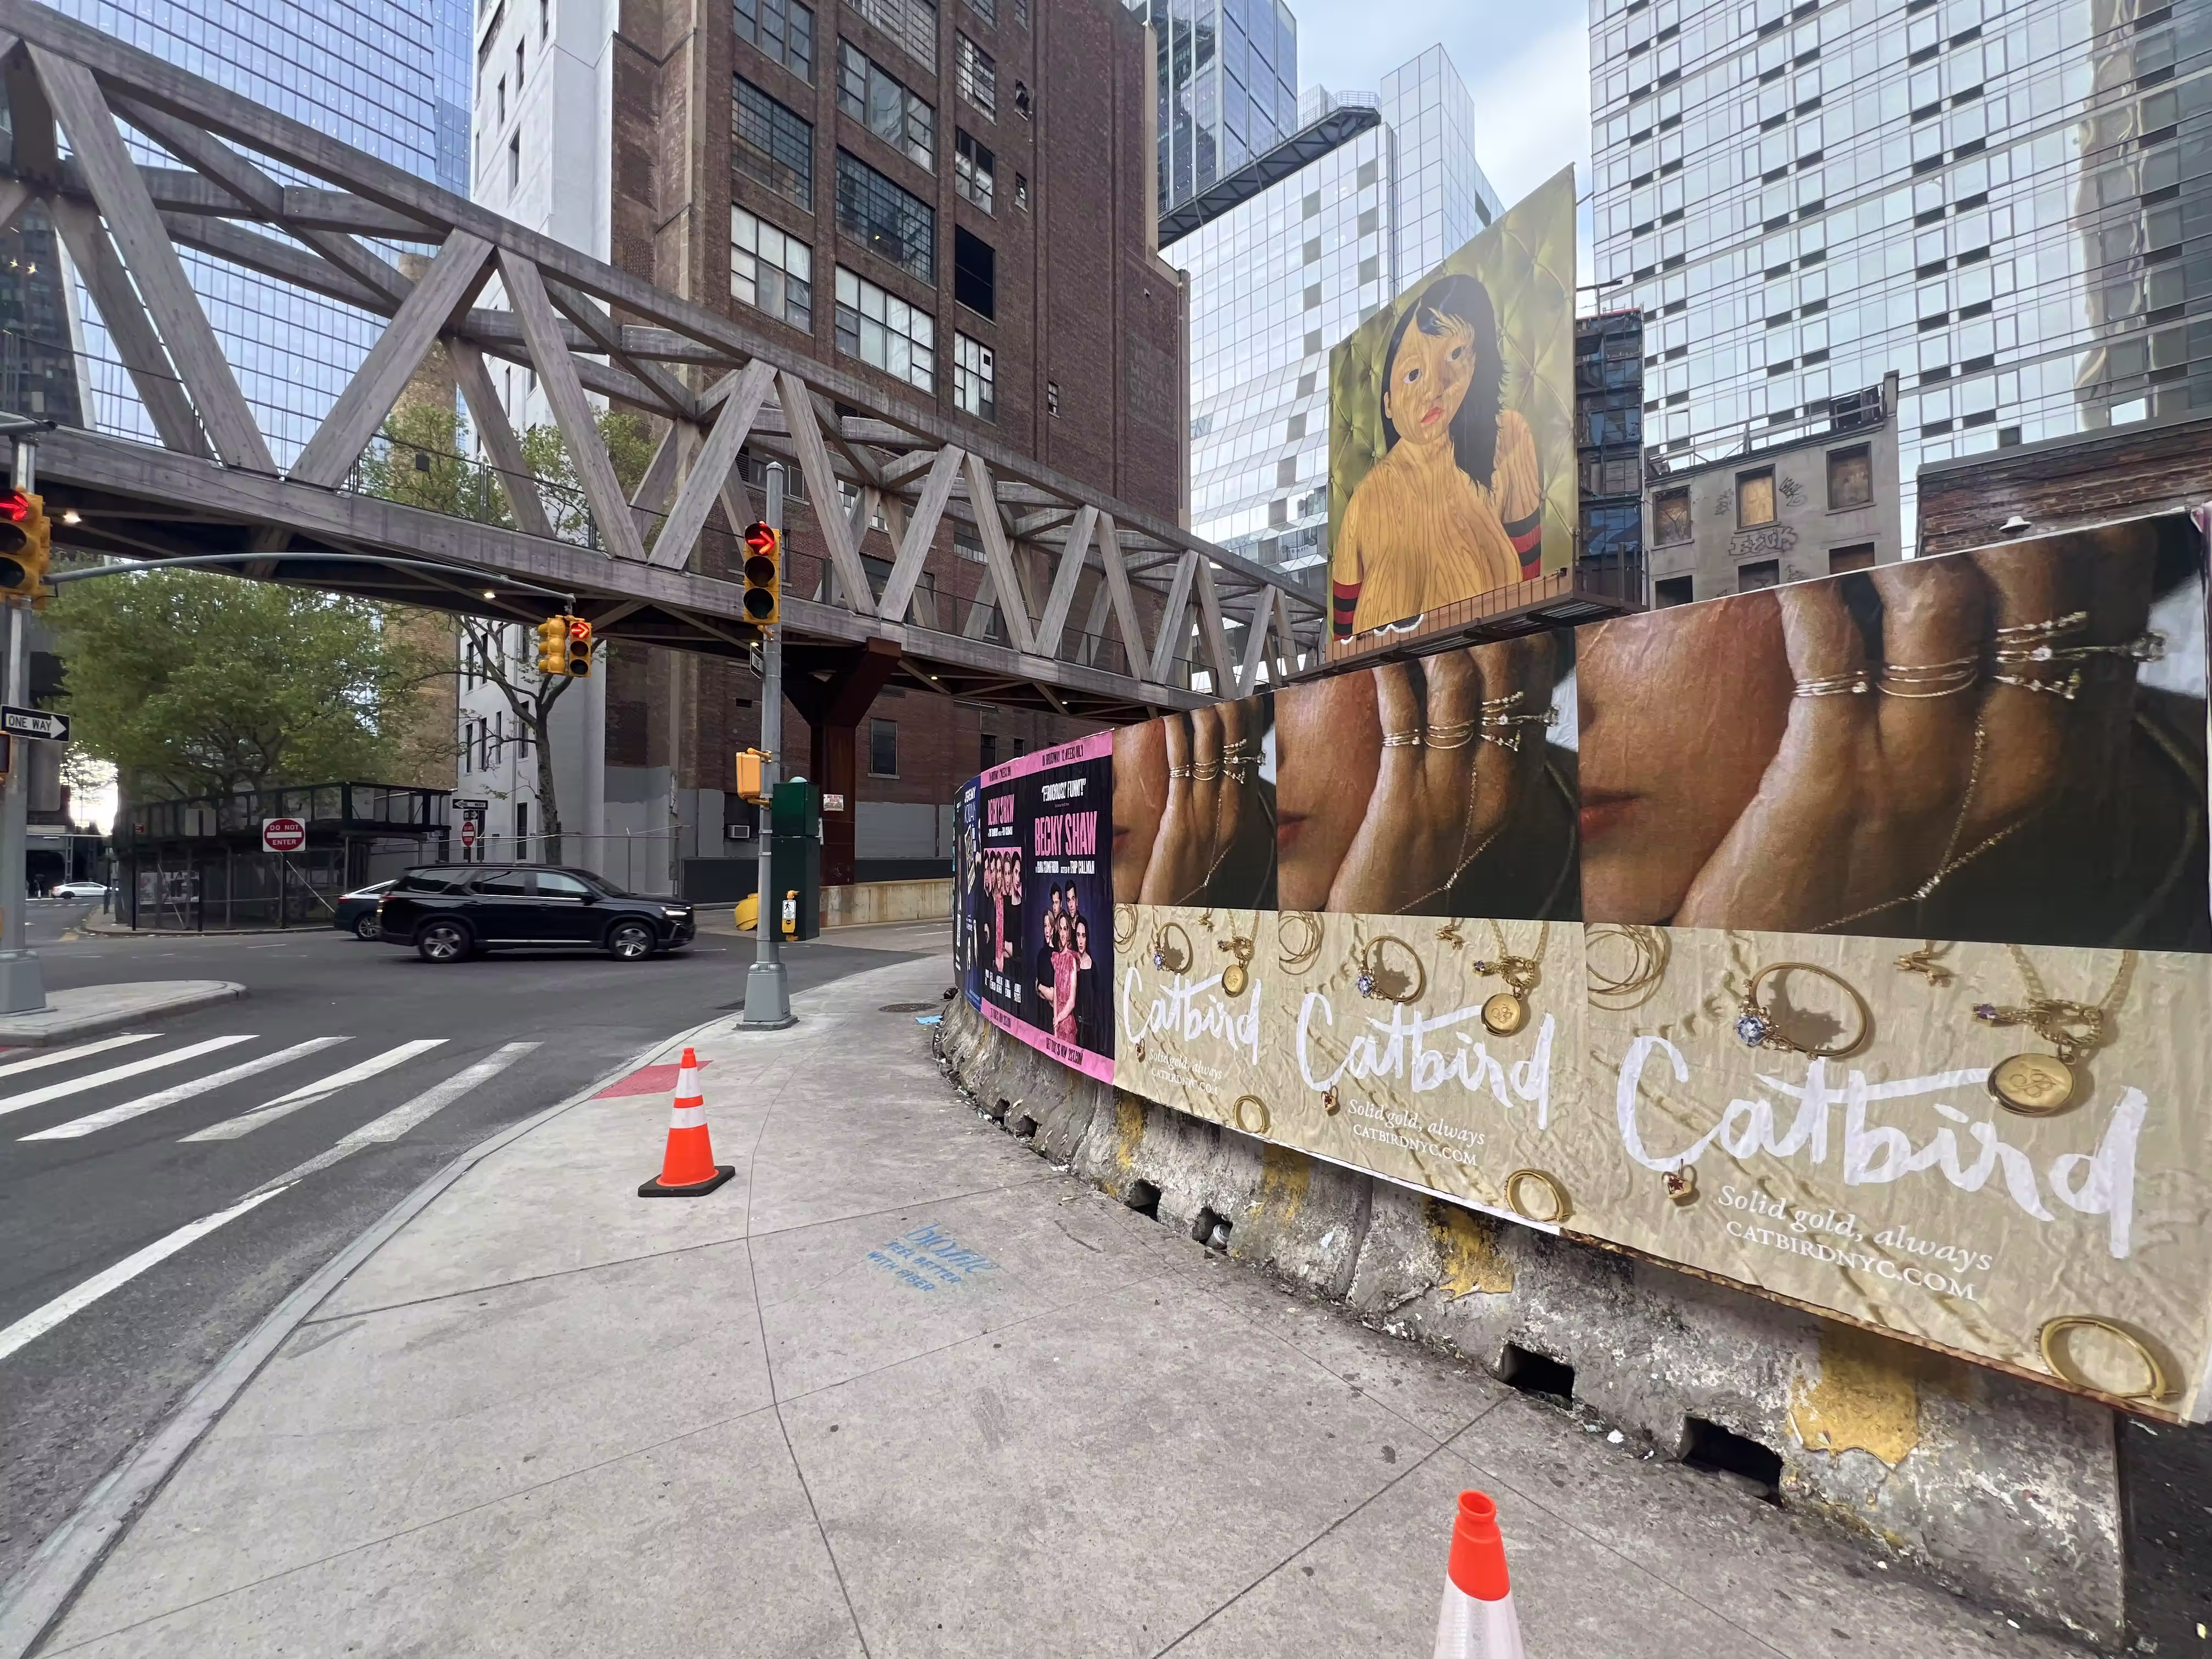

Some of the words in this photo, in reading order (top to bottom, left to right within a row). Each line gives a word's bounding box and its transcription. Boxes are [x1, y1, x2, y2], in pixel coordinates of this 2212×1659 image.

[8, 715, 27, 728] ONE
[32, 718, 52, 731] WAY
[1000, 794, 1014, 824] SHAW
[1035, 814, 1063, 856] BECKY
[1065, 811, 1097, 856] SHAW
[1124, 967, 1261, 1065] Catbird
[1149, 1048, 1169, 1064] Solid
[1168, 1054, 1190, 1071] gold,
[1192, 1060, 1222, 1081] always
[1296, 992, 1556, 1130] Catbird
[1348, 1099, 1384, 1120] Solid
[1385, 1110, 1423, 1132] gold,
[1427, 1118, 1486, 1148] always
[1353, 1124, 1478, 1166] CATBIRDNYC.COM
[1616, 1035, 2149, 1259] Catbird
[1718, 1185, 1787, 1220] Solid
[1790, 1209, 1865, 1243] gold,
[1872, 1225, 1993, 1273] always
[867, 1251, 900, 1270] WITH
[895, 1268, 936, 1291] FIBER
[912, 1256, 961, 1284] BETTER
[1726, 1220, 1978, 1301] CATBIRDNYC.COM
